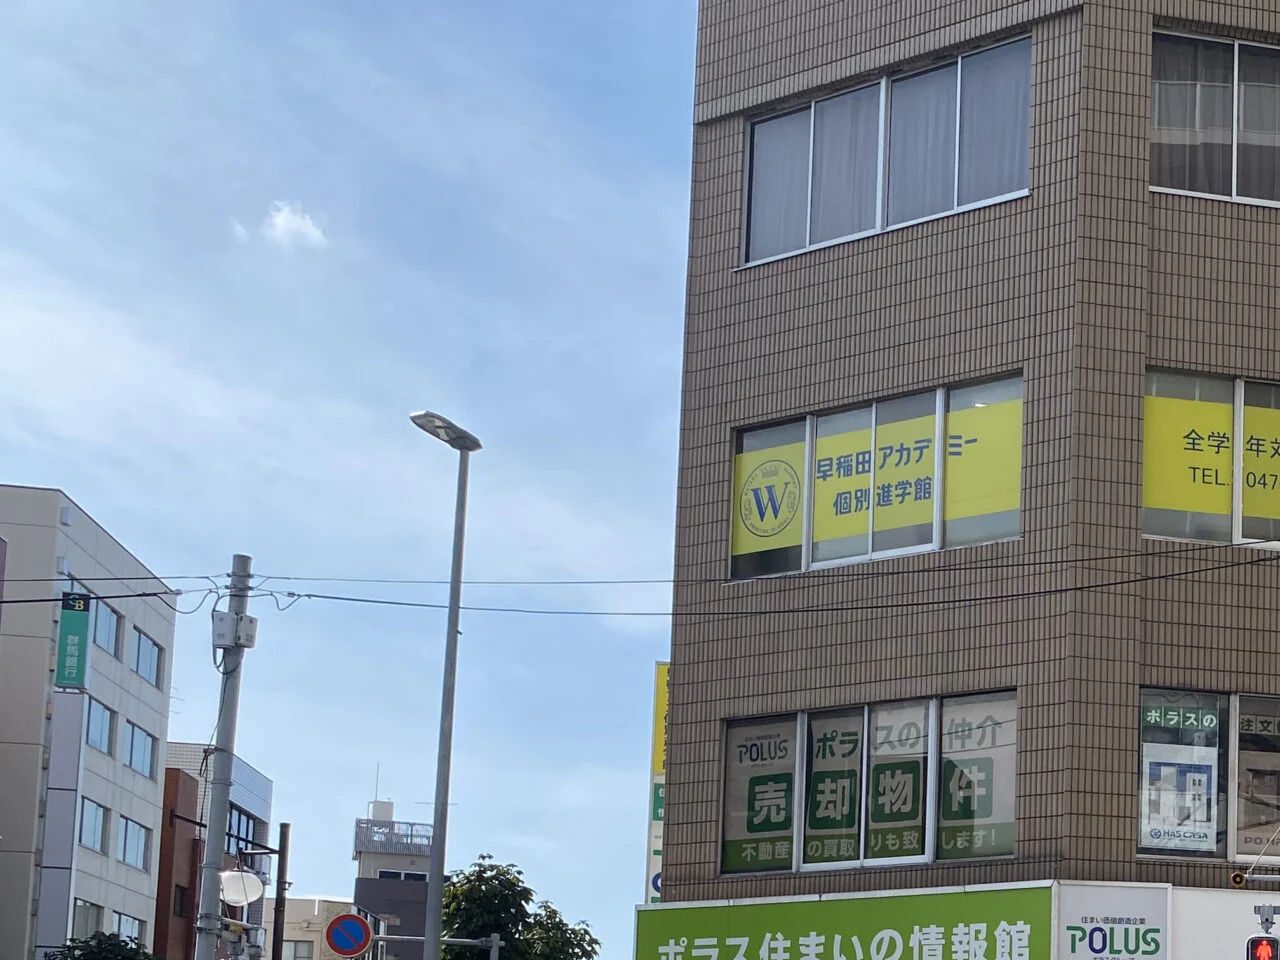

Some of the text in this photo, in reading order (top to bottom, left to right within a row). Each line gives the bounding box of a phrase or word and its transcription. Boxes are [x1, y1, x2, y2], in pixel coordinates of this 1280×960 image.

[815, 434, 978, 481] 早稲田アカデミー
[750, 481, 792, 523] W
[833, 476, 933, 516] 個別進学館
[1146, 709, 1217, 728] ポラスの
[736, 739, 789, 764] POLUS
[752, 765, 988, 826] 売却物件
[1066, 925, 1161, 956] POLUS
